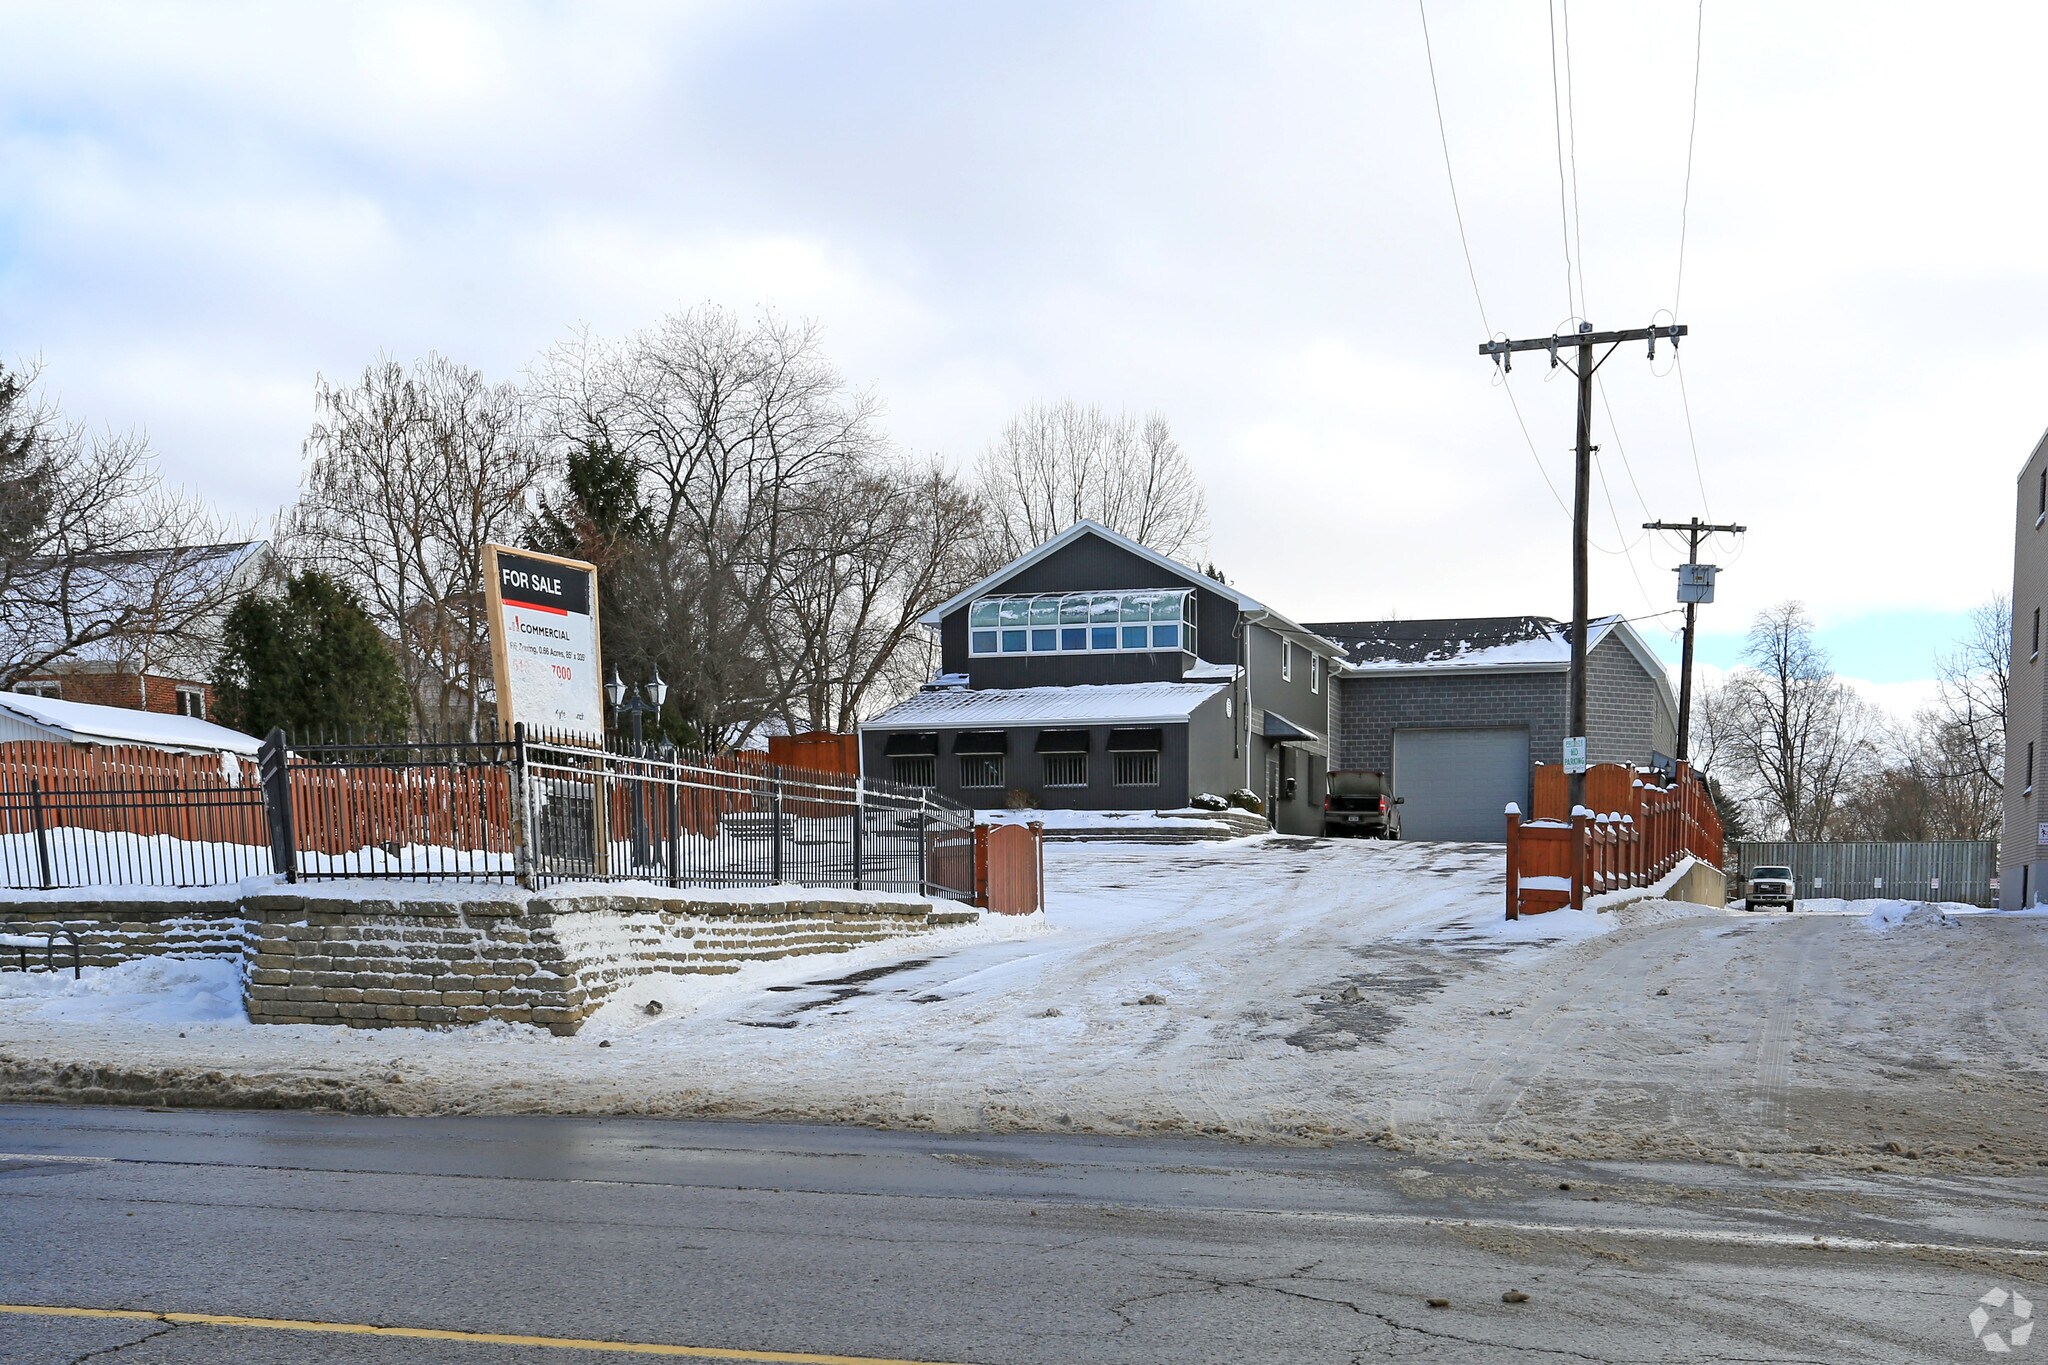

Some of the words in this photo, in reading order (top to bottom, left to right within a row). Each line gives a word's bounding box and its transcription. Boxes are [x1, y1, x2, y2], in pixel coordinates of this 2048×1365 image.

[502, 569, 529, 589] FOR
[531, 574, 562, 595] SALE
[520, 623, 570, 641] COMMERCIAL
[551, 665, 572, 681] 7000
[1571, 748, 1579, 756] NO
[1565, 757, 1584, 765] PARKING
